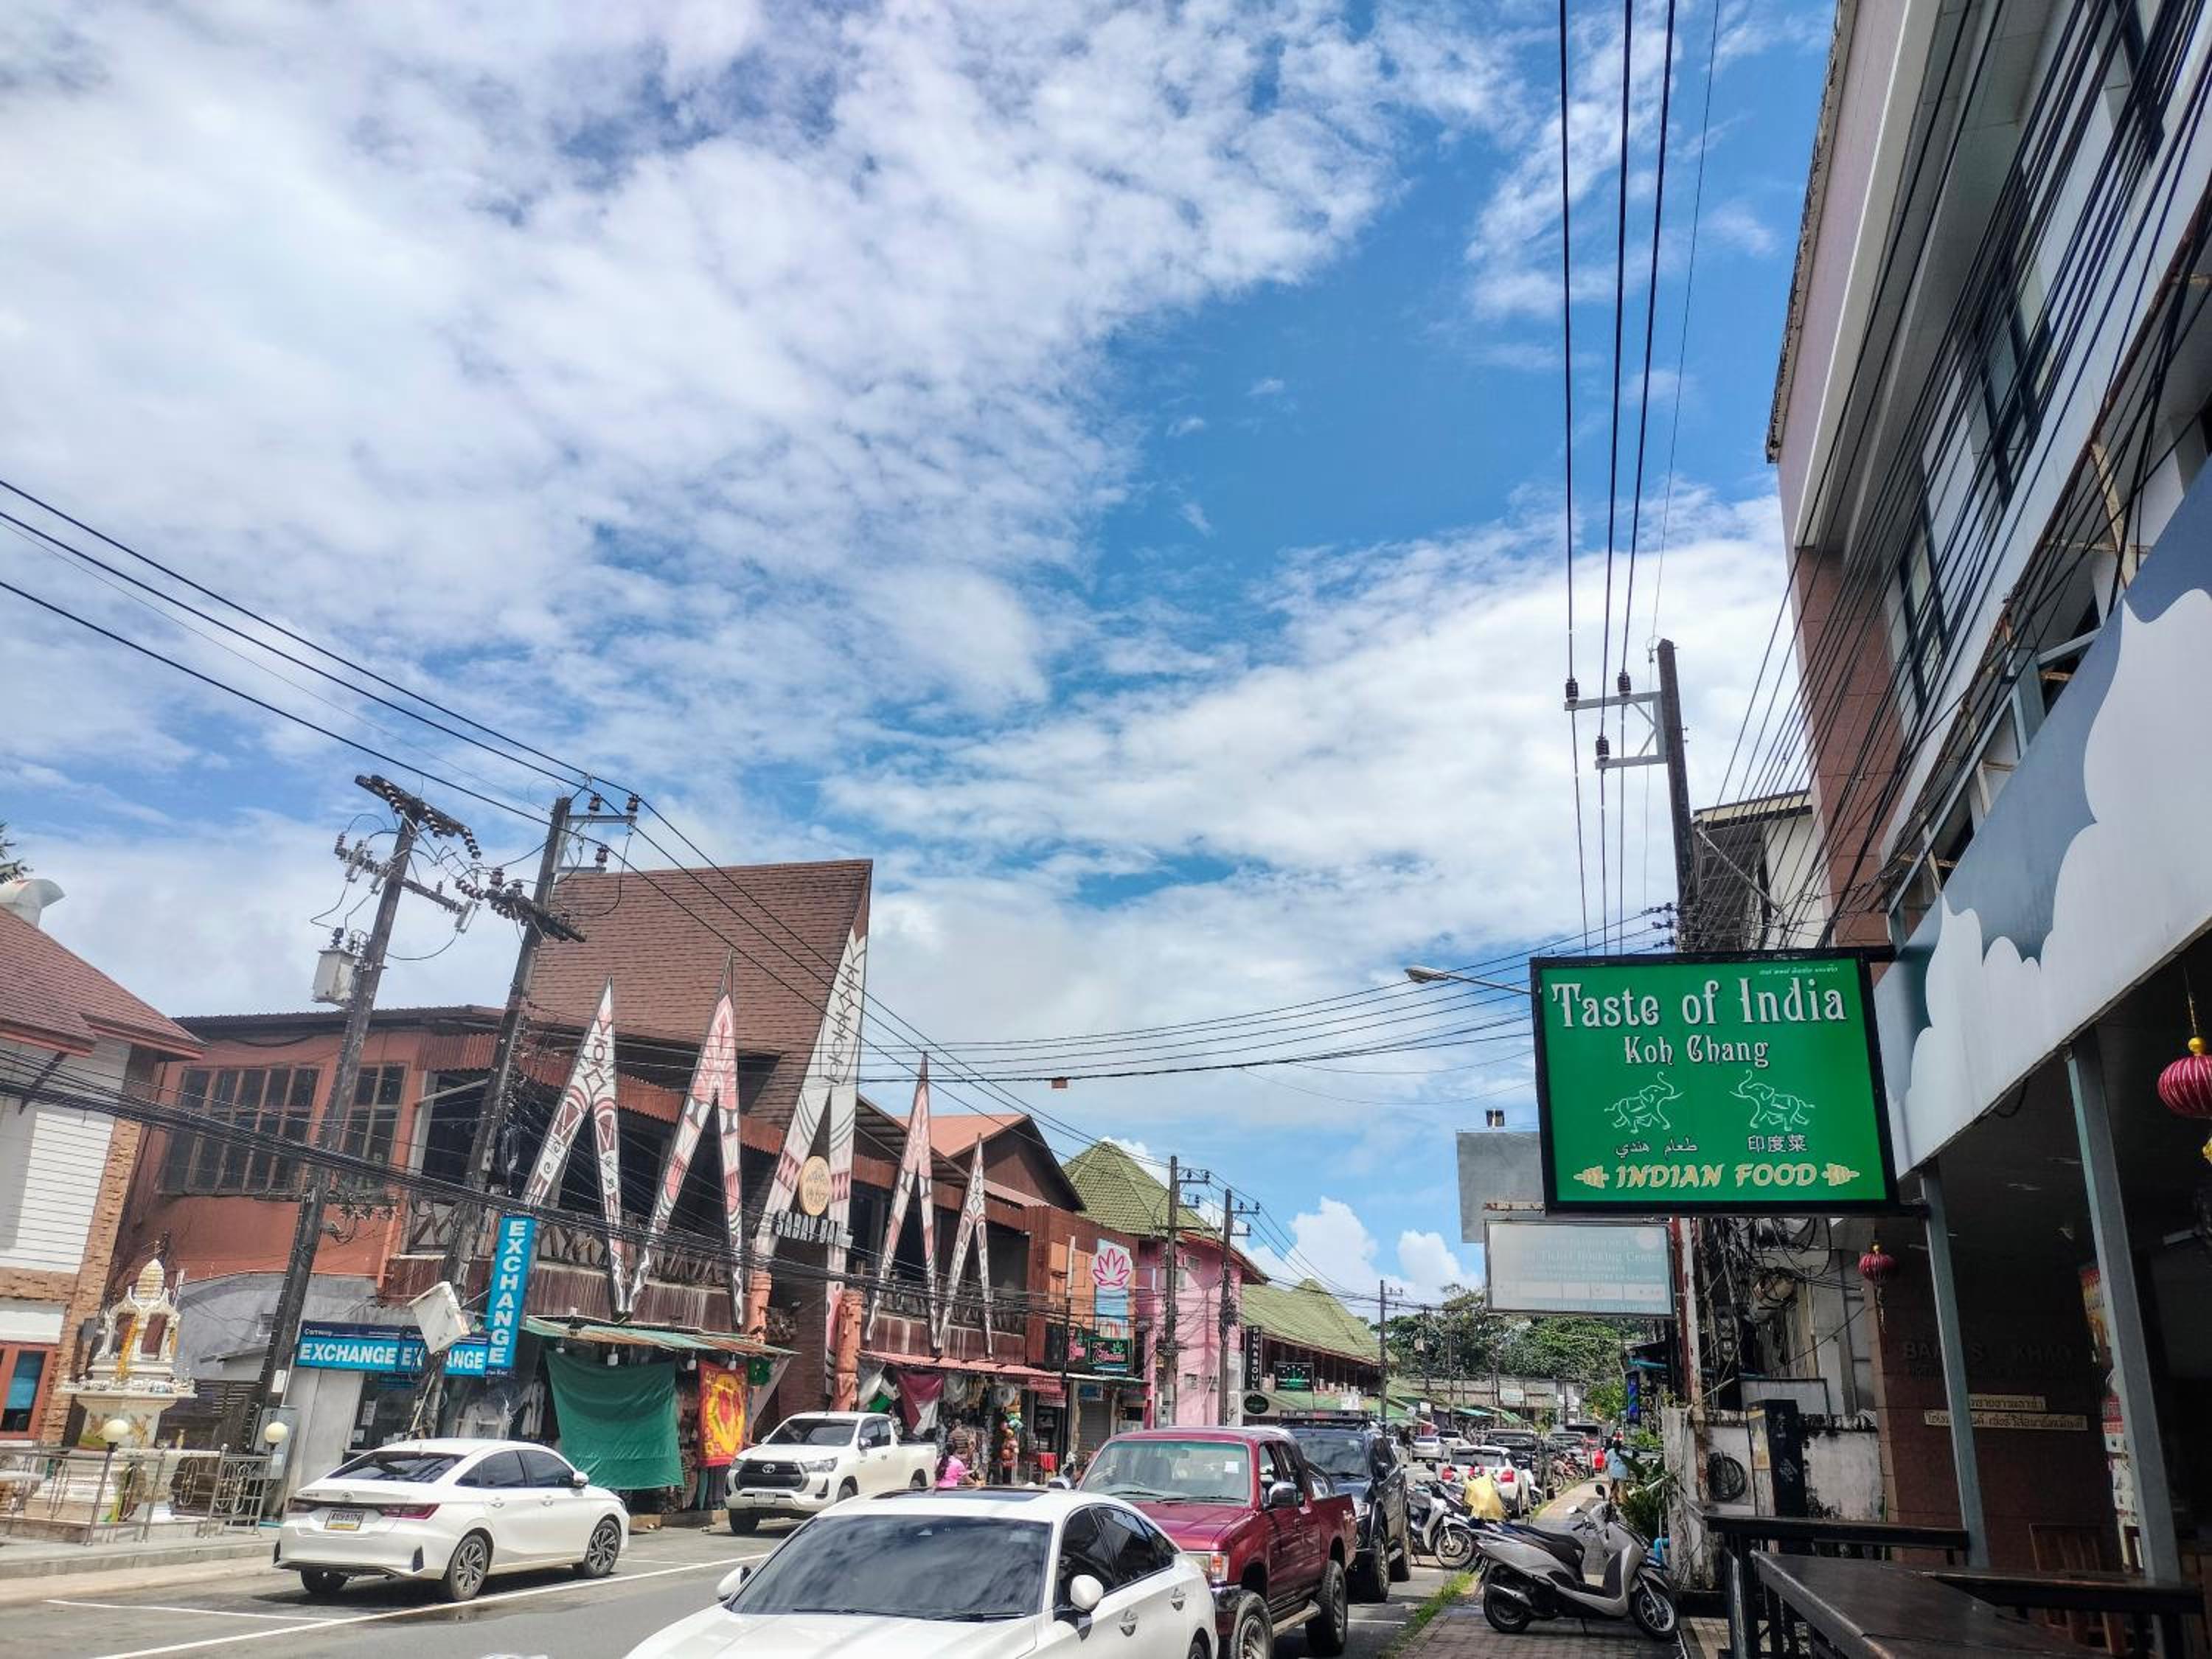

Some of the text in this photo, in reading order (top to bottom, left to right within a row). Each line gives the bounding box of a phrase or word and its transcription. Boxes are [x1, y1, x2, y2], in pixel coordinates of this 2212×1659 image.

[1551, 977, 1846, 1028] Taste of India
[1624, 1034, 1770, 1068] Koh Chang
[1615, 1137, 1699, 1160] طعام هندي
[1748, 1134, 1807, 1153] 印度菜
[1615, 1164, 1818, 1189] INDIAN FOOD
[487, 1220, 527, 1363] EXCHANGE
[299, 1343, 397, 1365] EXCHANGE
[400, 1346, 484, 1369] EXANGE
